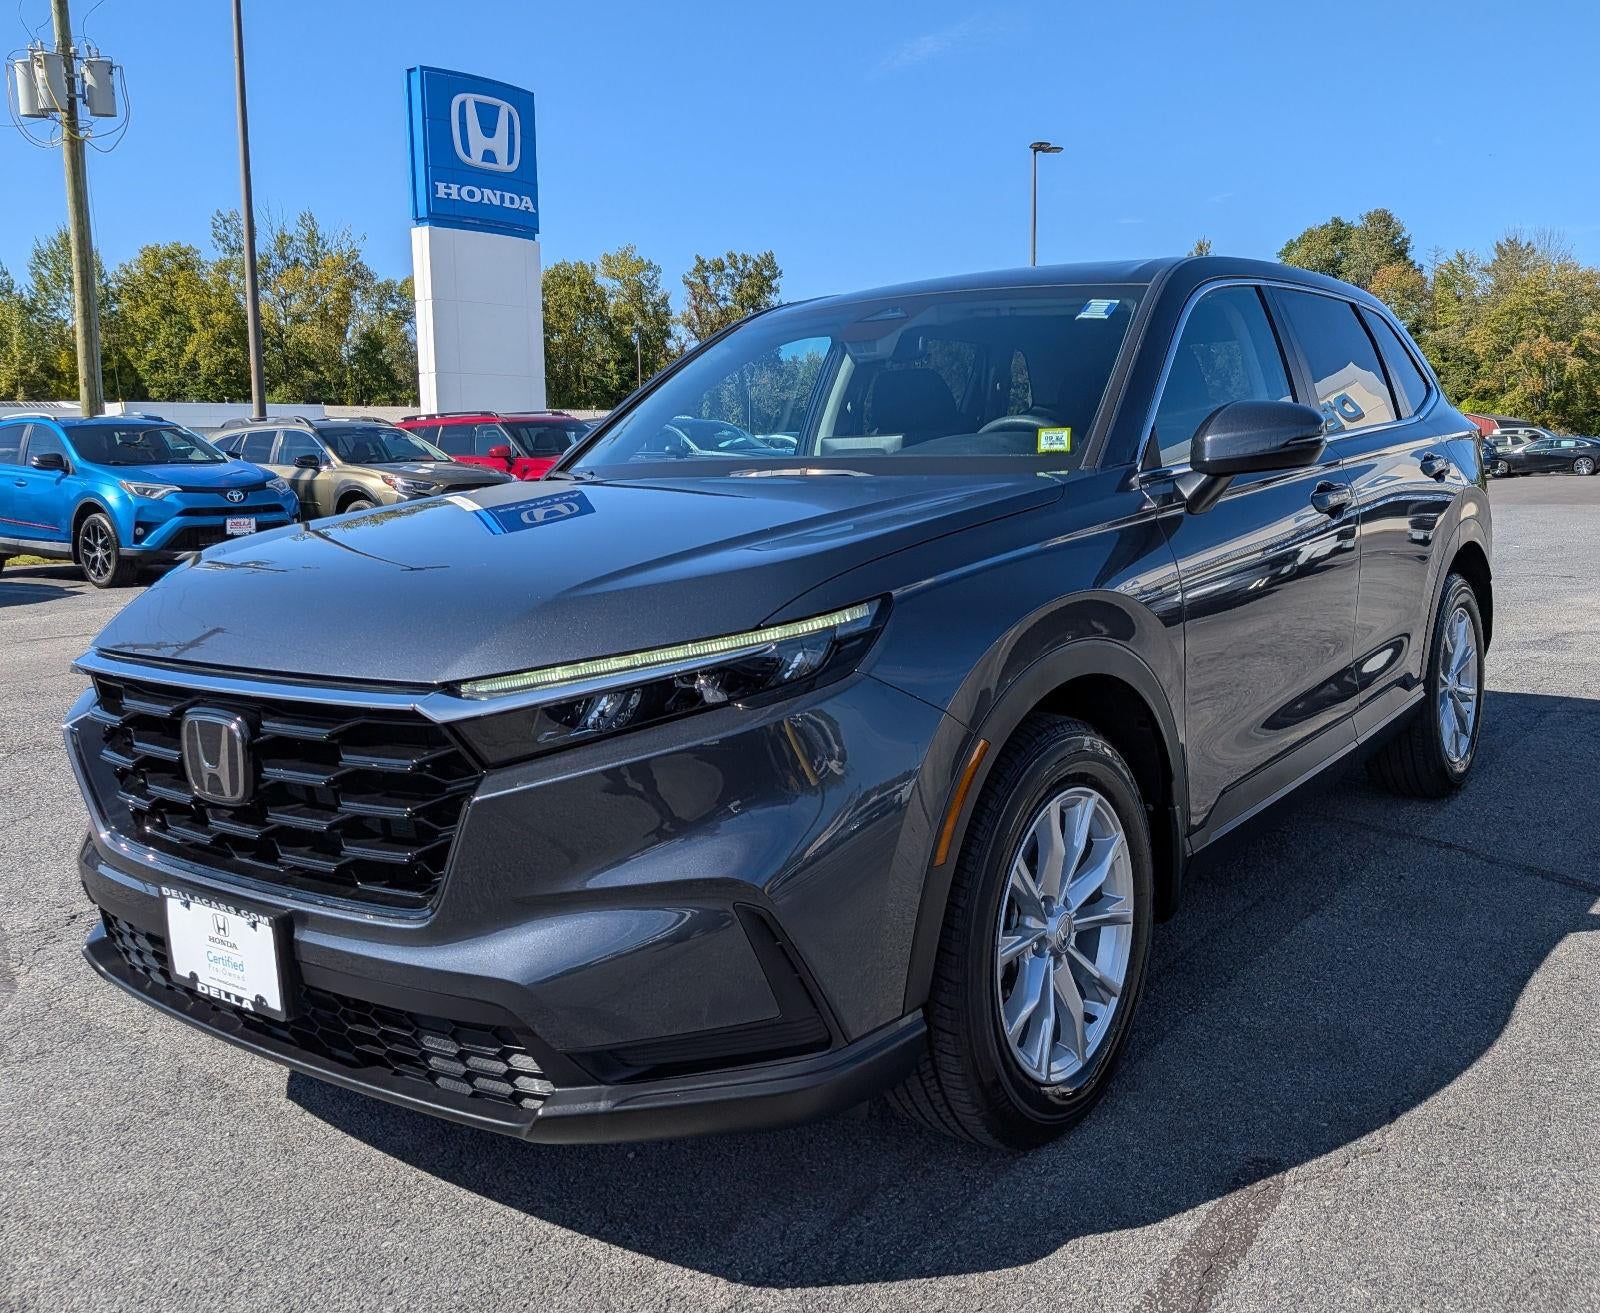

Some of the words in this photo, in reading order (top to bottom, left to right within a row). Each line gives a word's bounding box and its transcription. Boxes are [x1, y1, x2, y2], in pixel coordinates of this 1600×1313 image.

[435, 181, 537, 213] HONDA
[161, 886, 270, 926] DELLACARS.COM
[208, 935, 239, 951] HONDA
[206, 951, 244, 973] Certified
[196, 982, 255, 1012] DELLA
